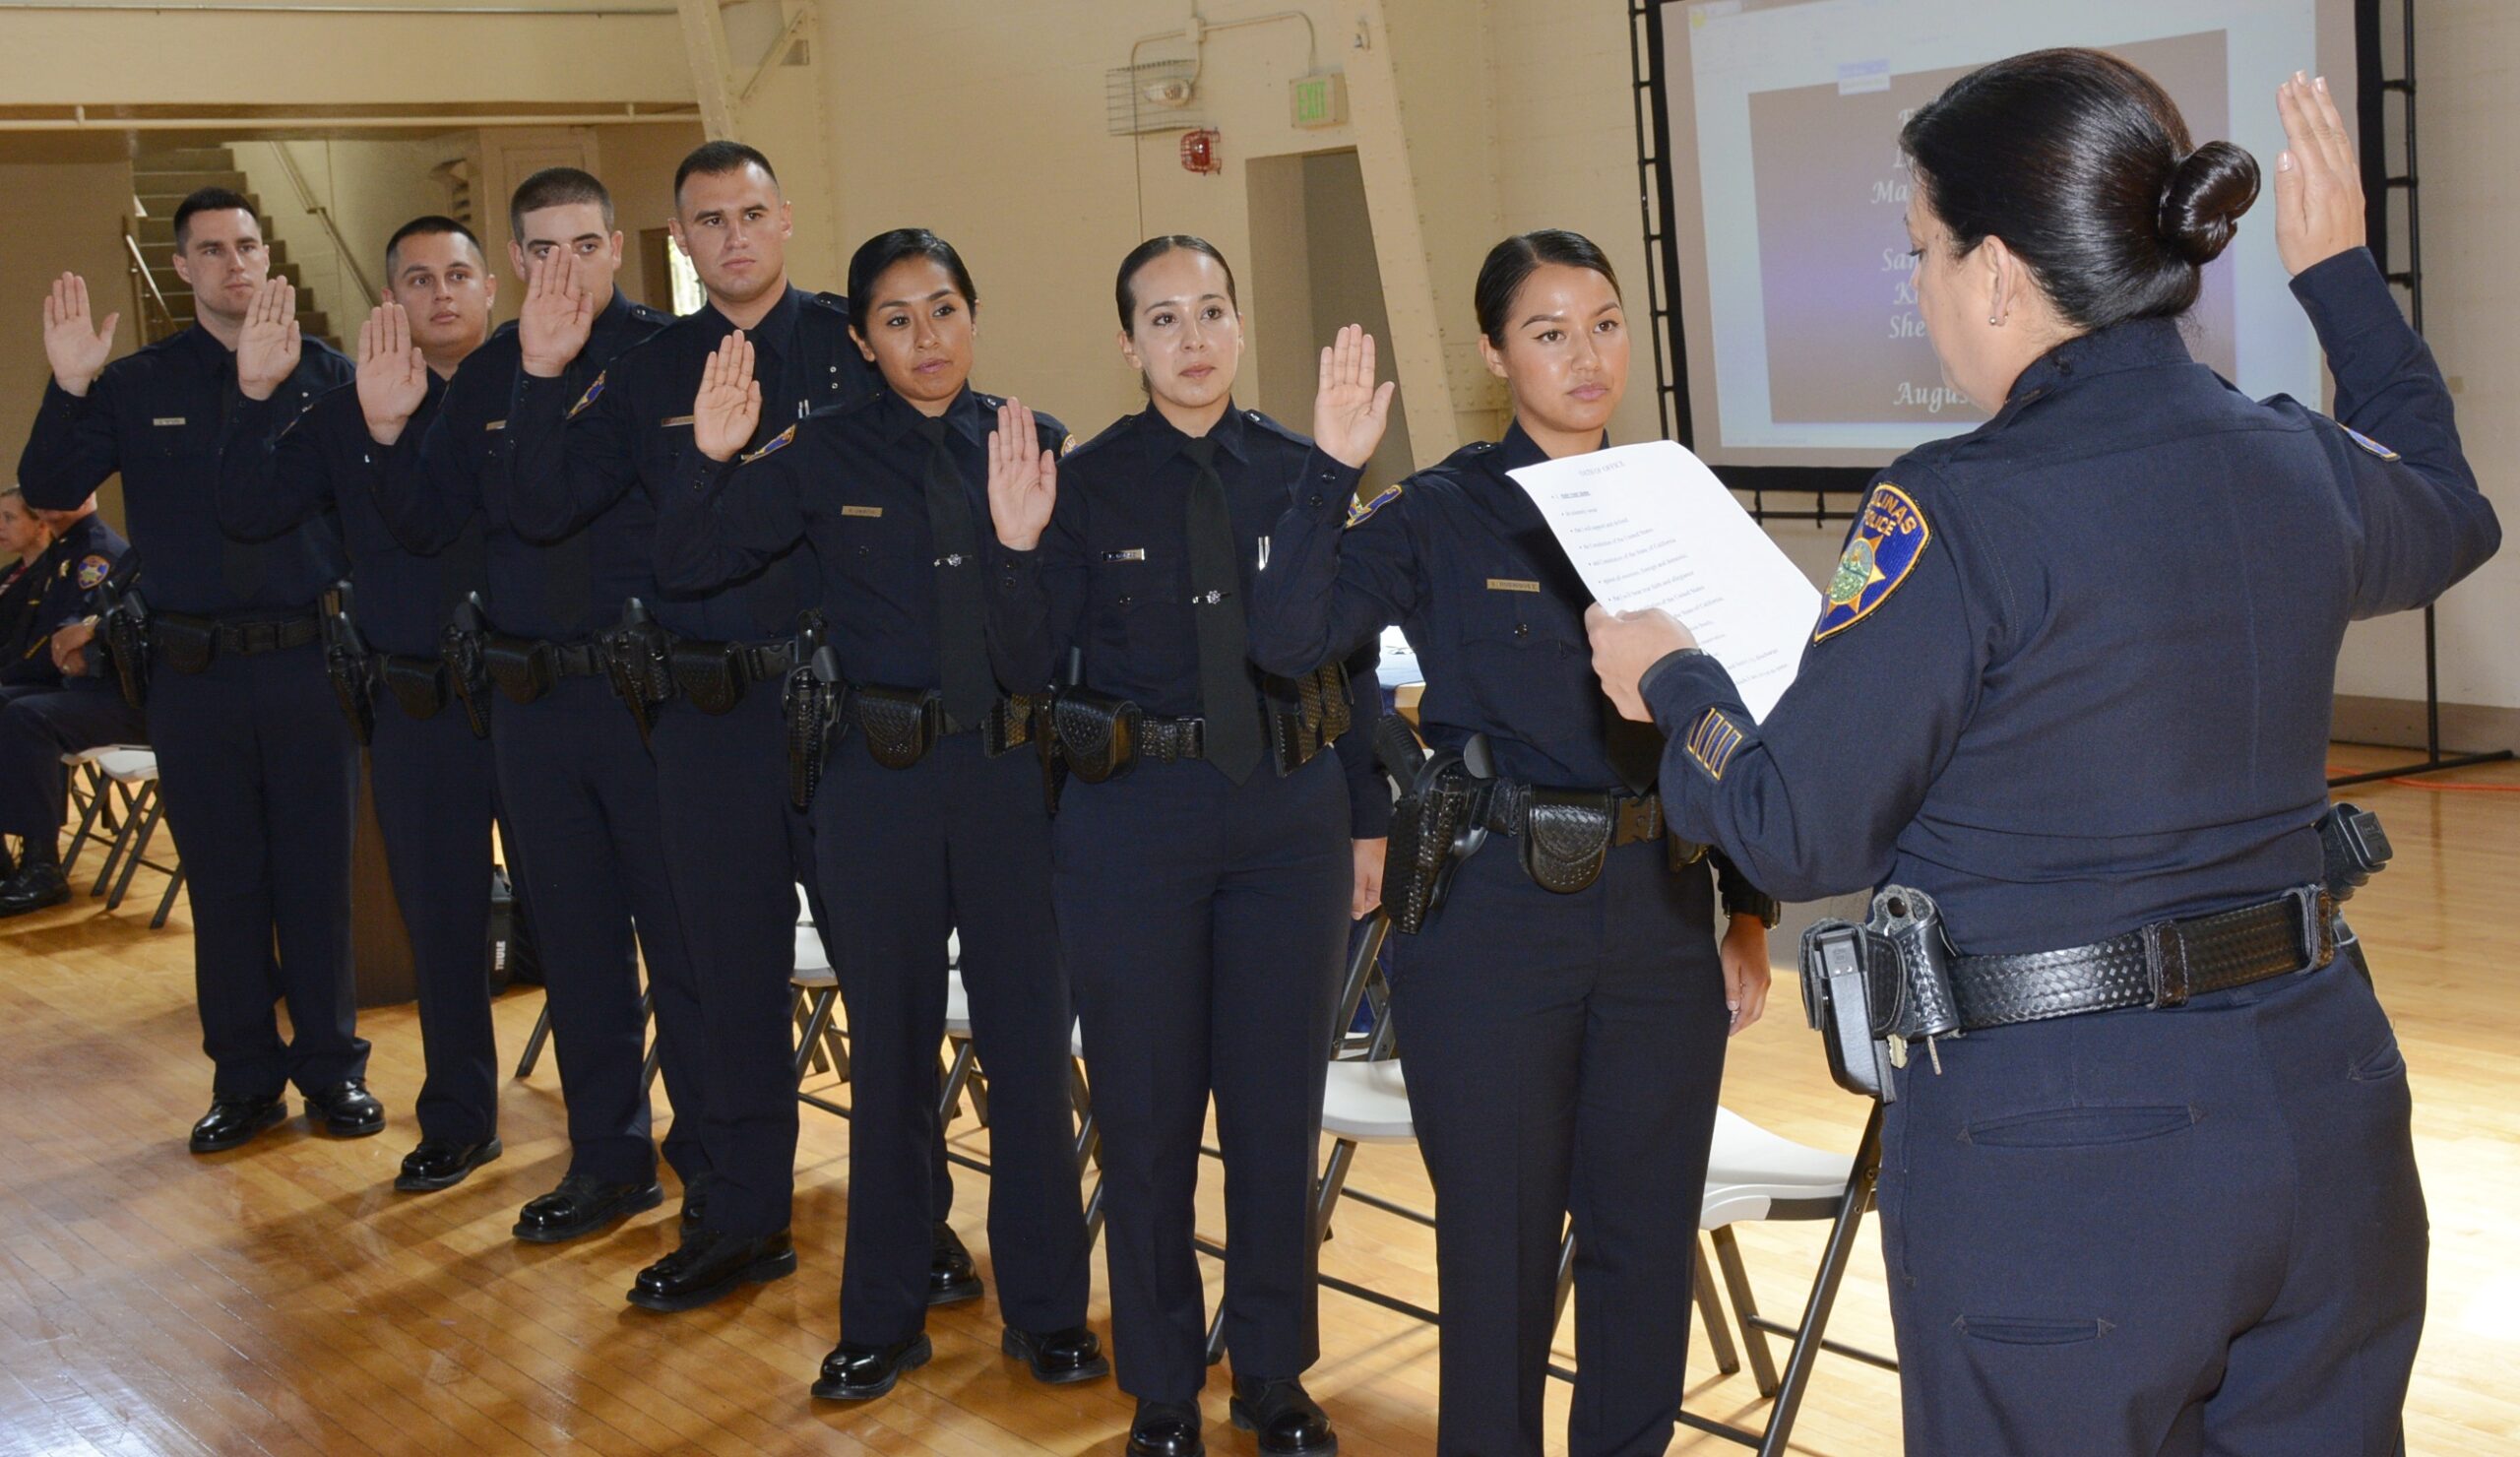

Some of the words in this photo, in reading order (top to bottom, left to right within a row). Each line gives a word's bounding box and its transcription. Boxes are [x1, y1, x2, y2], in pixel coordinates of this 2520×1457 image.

[1296, 80, 1327, 122] EXIT
[1870, 490, 1917, 535] LINAS
[495, 940, 506, 971] THULE
